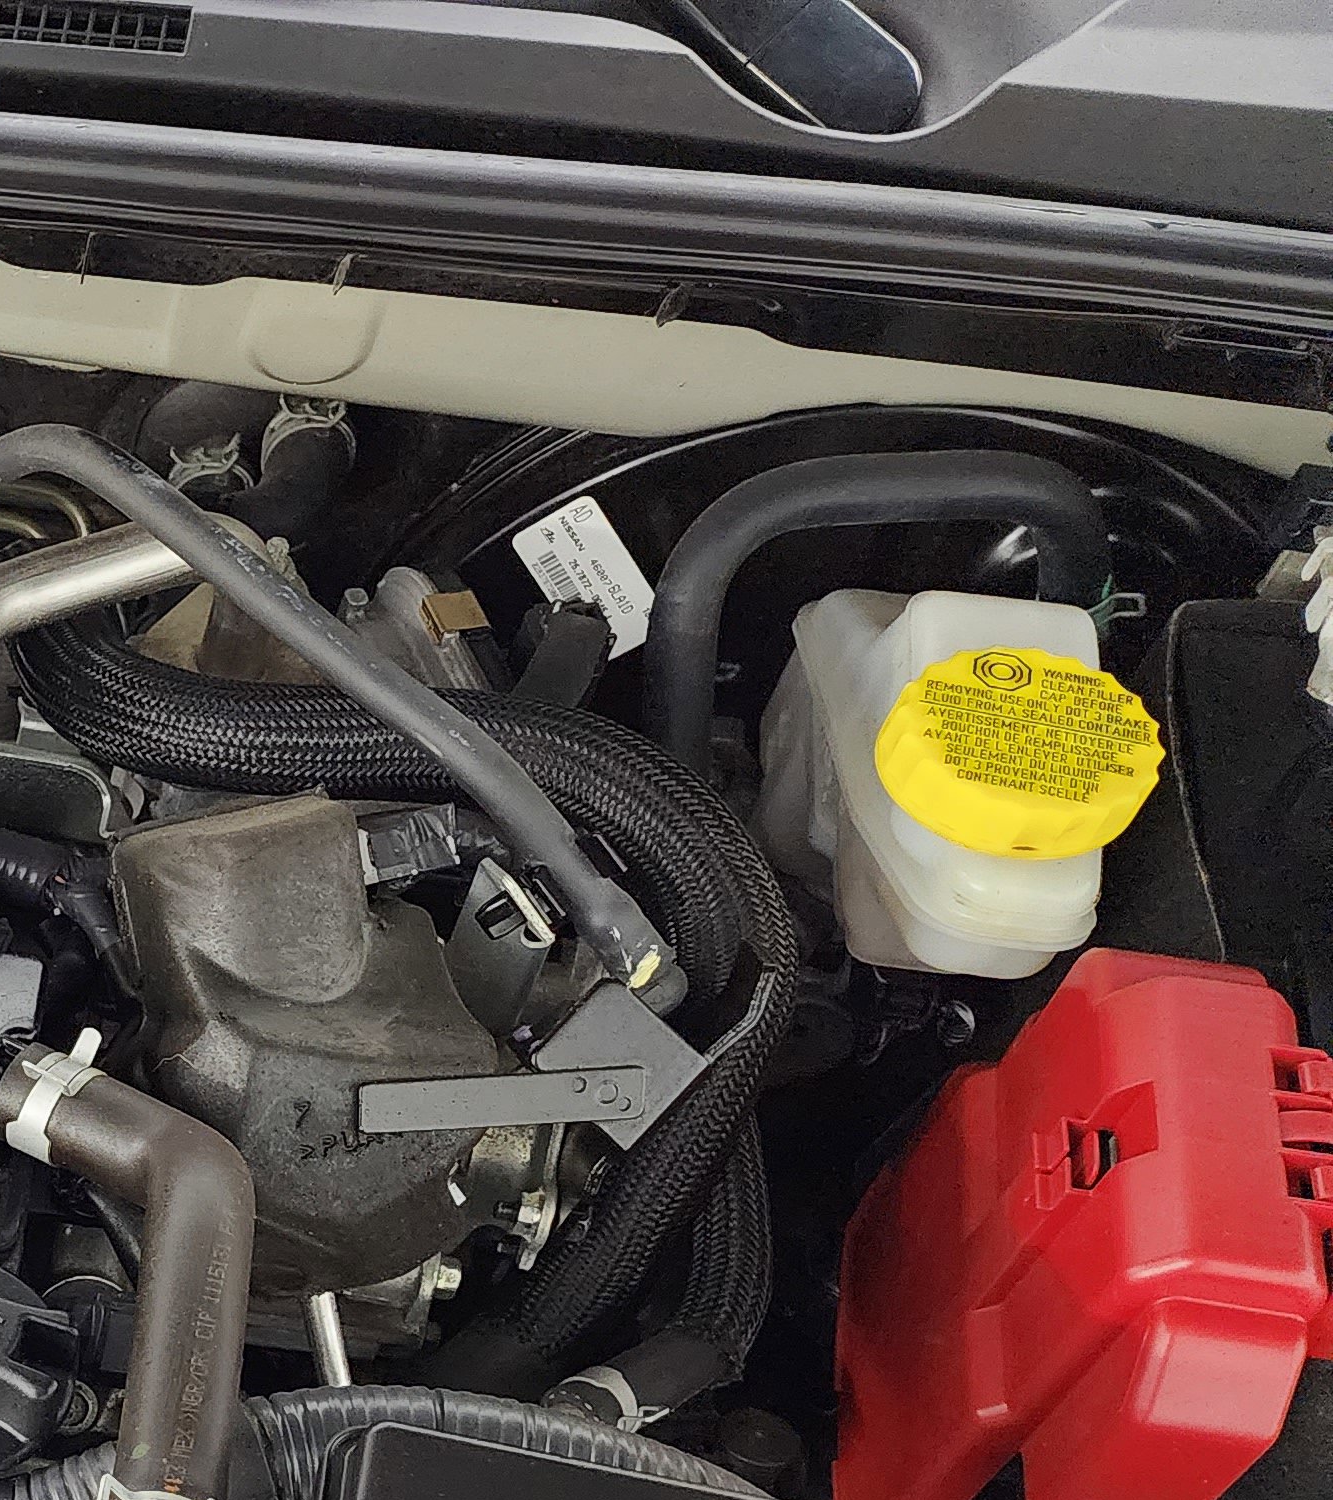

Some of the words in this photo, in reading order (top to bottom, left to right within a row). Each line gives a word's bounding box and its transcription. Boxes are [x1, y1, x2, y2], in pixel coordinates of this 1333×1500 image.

[569, 504, 594, 524] AD
[558, 515, 586, 552] NISSAN
[1039, 689, 1066, 704] CAP
[1072, 695, 1124, 714] BEFORE
[1040, 679, 1084, 695] CLEAN
[1088, 687, 1134, 705] FILLER
[924, 689, 962, 705] FLUID
[966, 697, 1004, 713] FROM
[1007, 704, 1018, 716] A
[1021, 707, 1074, 728] SEALED
[998, 692, 1024, 706] USE
[1026, 698, 1060, 713] ONLY
[1065, 705, 1090, 720] DOT
[1094, 711, 1102, 721] 3
[1104, 714, 1151, 731] BRAKE
[922, 726, 971, 746] AVANT
[974, 735, 990, 749] DE
[940, 719, 999, 740] BOUCHON
[1003, 730, 1020, 743] DE
[1023, 734, 1118, 763] REMPLISSAGE
[1045, 728, 1116, 752] NETTOYER
[1119, 741, 1134, 755] LE
[944, 753, 969, 768] DOT
[972, 758, 982, 770] 3
[984, 761, 1065, 786] PROVENANT
[945, 741, 1025, 766] SEULEMENT
[1028, 757, 1046, 770] DU
[1049, 761, 1101, 782] LIQUIDE
[955, 767, 1034, 792] CONTENANT
